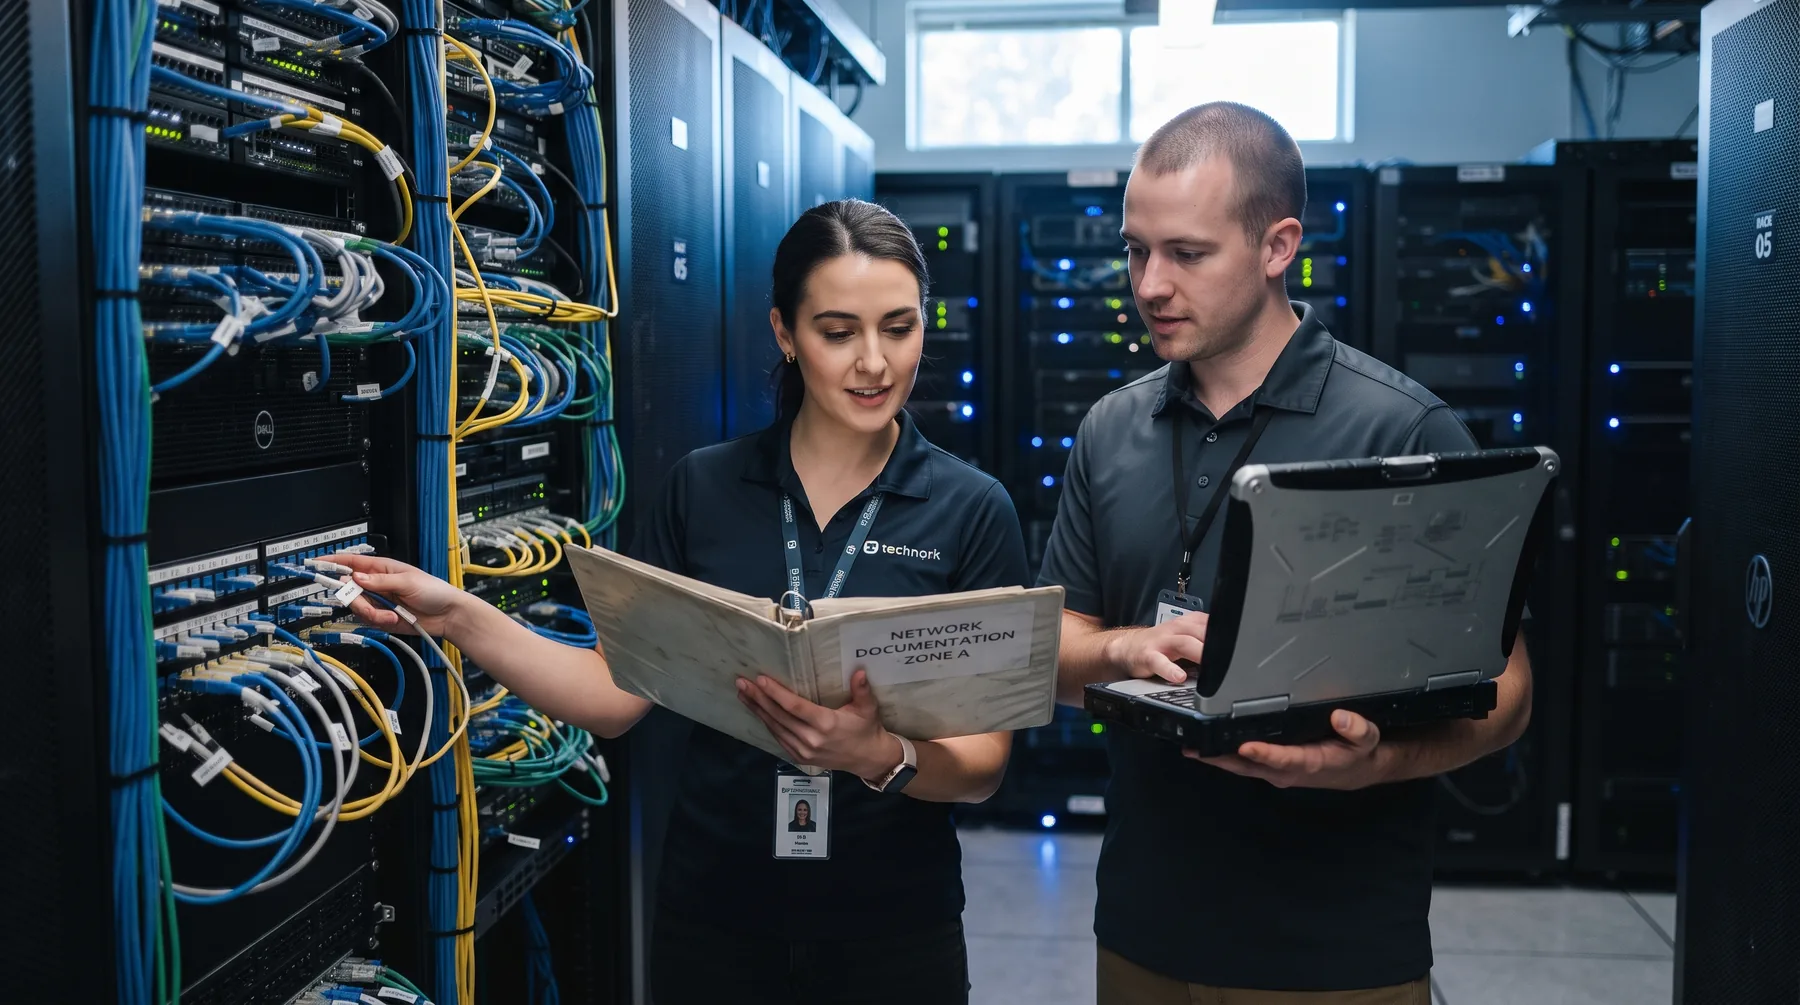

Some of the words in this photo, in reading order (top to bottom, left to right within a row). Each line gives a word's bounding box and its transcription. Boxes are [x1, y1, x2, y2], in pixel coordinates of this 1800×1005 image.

[1755, 231, 1772, 259] 05
[257, 424, 273, 435] DELL
[881, 544, 941, 560] technork
[1747, 556, 1770, 627] hp
[890, 621, 983, 641] NETWORK
[855, 630, 1015, 658] DOCUMENTATION
[904, 651, 953, 664] ZONE
[957, 649, 970, 658] A
